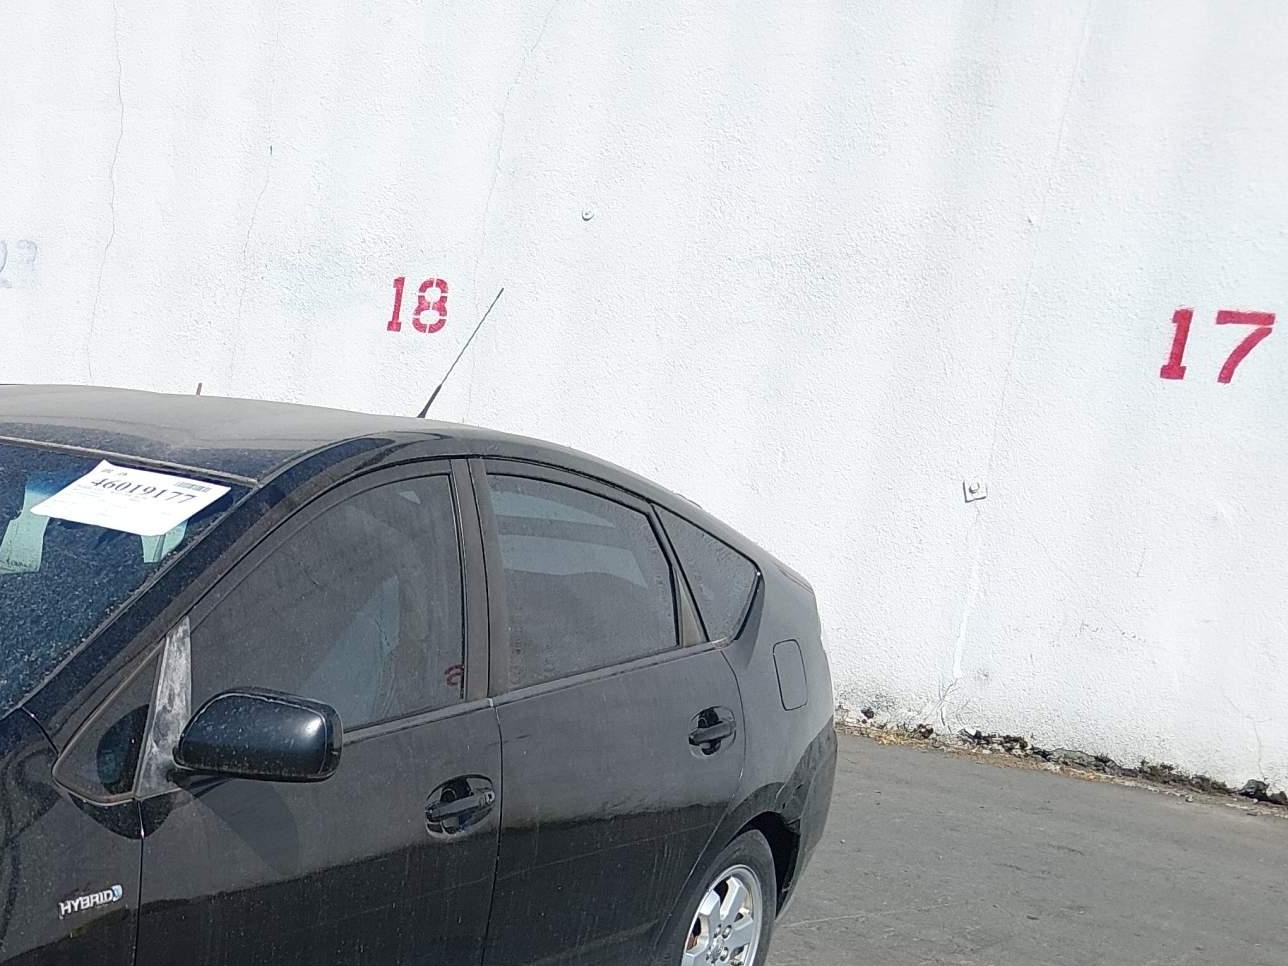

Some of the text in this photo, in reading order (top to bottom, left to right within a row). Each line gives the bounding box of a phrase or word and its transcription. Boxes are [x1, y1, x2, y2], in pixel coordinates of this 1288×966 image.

[386, 277, 449, 334] 18
[1159, 307, 1277, 385] 17
[91, 478, 197, 504] 46019177
[58, 889, 114, 916] HYBRID
